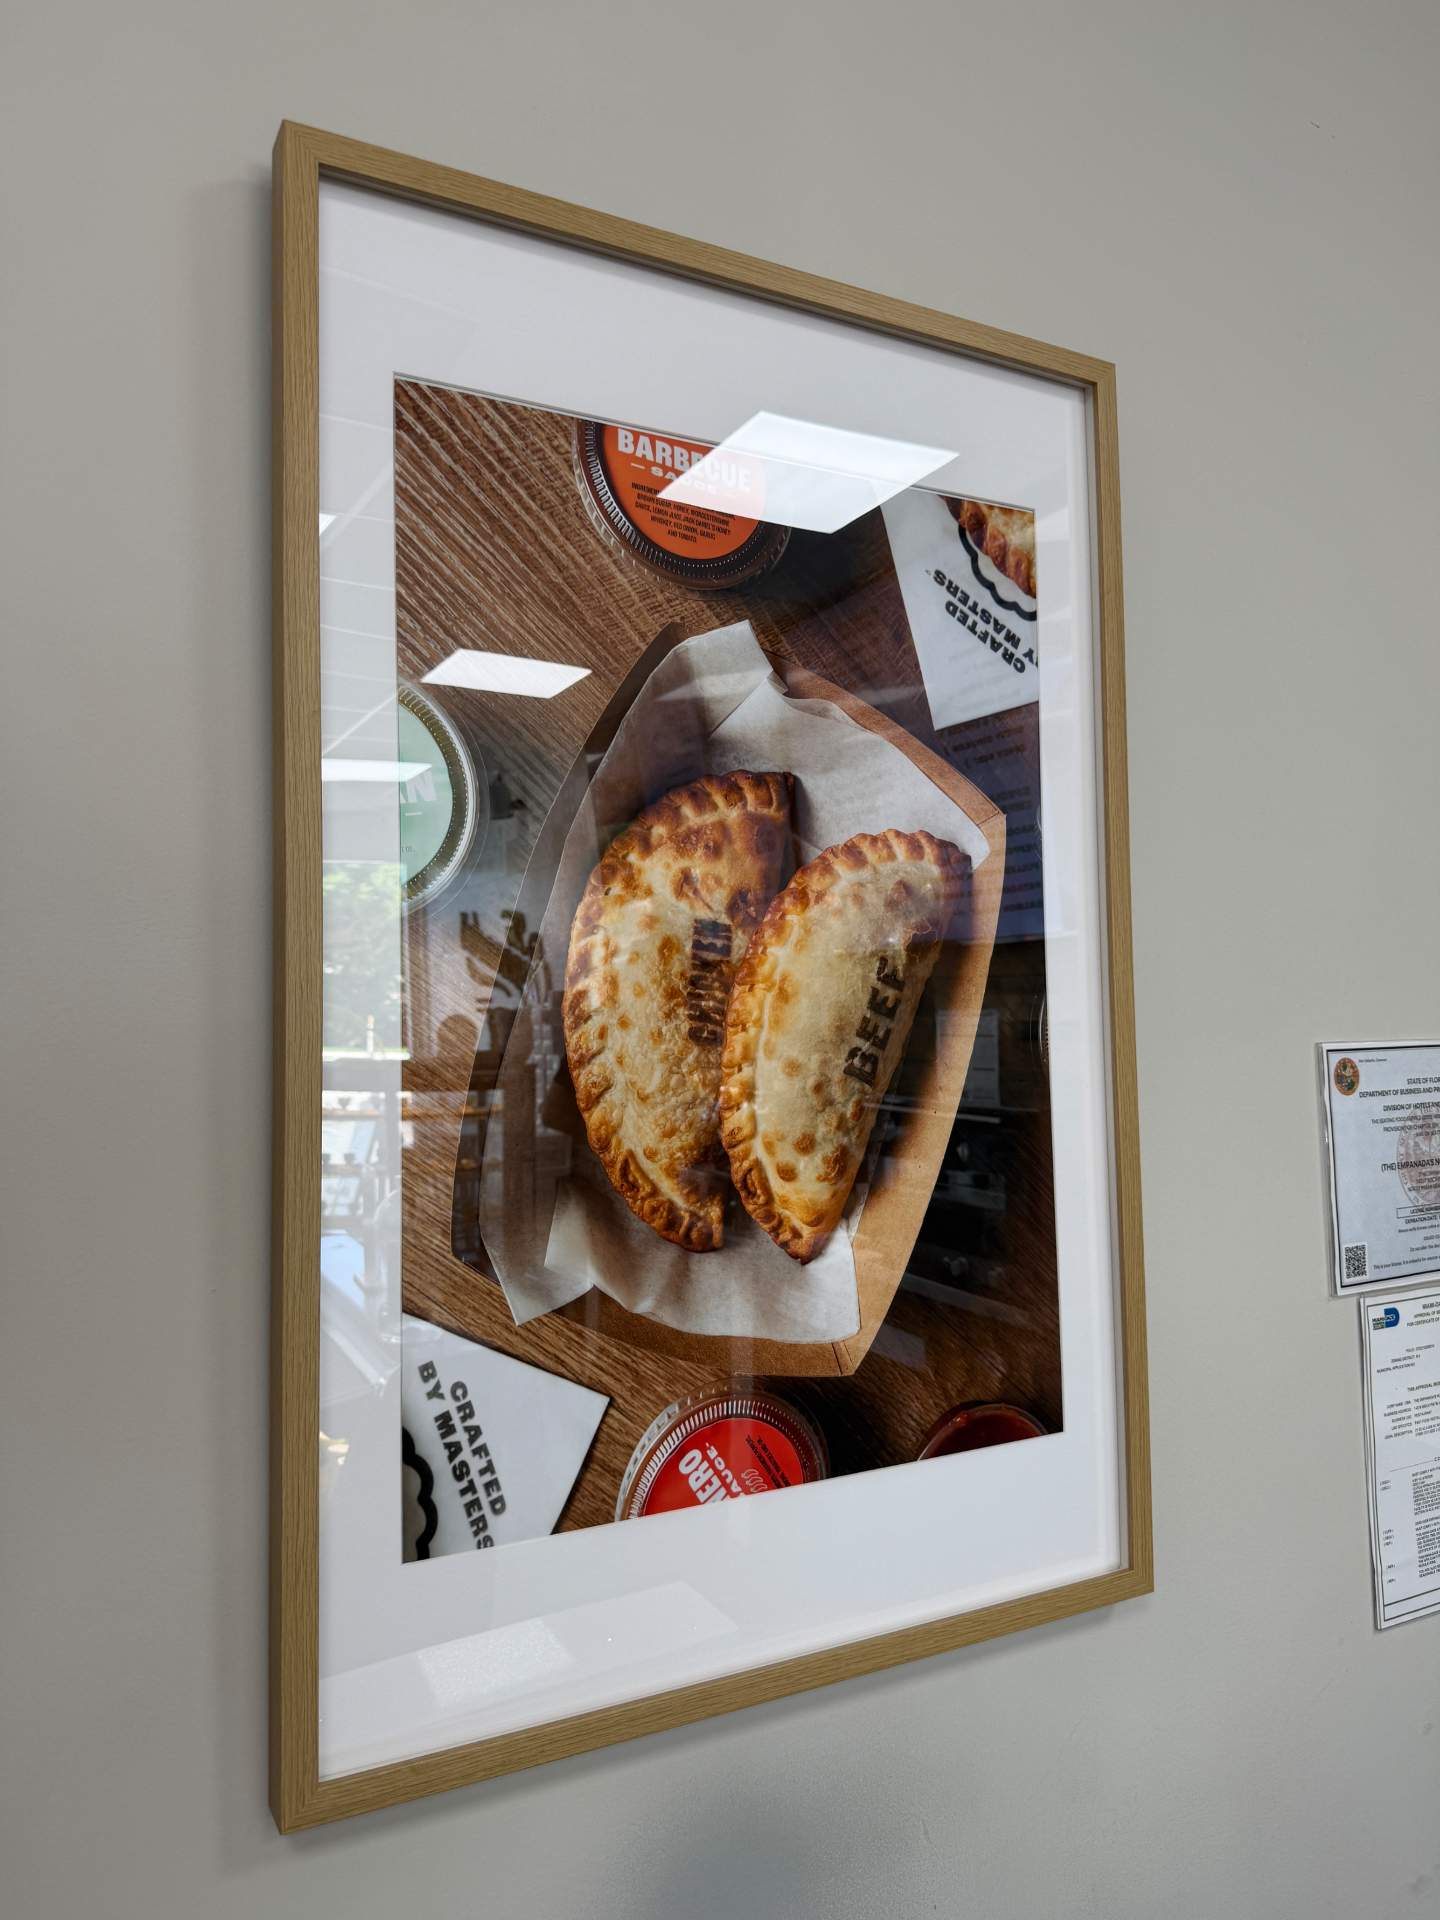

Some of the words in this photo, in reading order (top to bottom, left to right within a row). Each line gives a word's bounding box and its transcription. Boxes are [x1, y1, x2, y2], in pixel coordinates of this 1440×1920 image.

[618, 428, 751, 493] BARBECUE
[652, 506, 668, 518] LEMON
[933, 569, 1021, 651] MASTERS
[945, 600, 1026, 674] CRAFTED
[842, 957, 905, 1088] BEEF
[1359, 1090, 1391, 1098] DEPARTMENT
[417, 1360, 446, 1401] BY
[451, 1381, 507, 1516] CRAFTED
